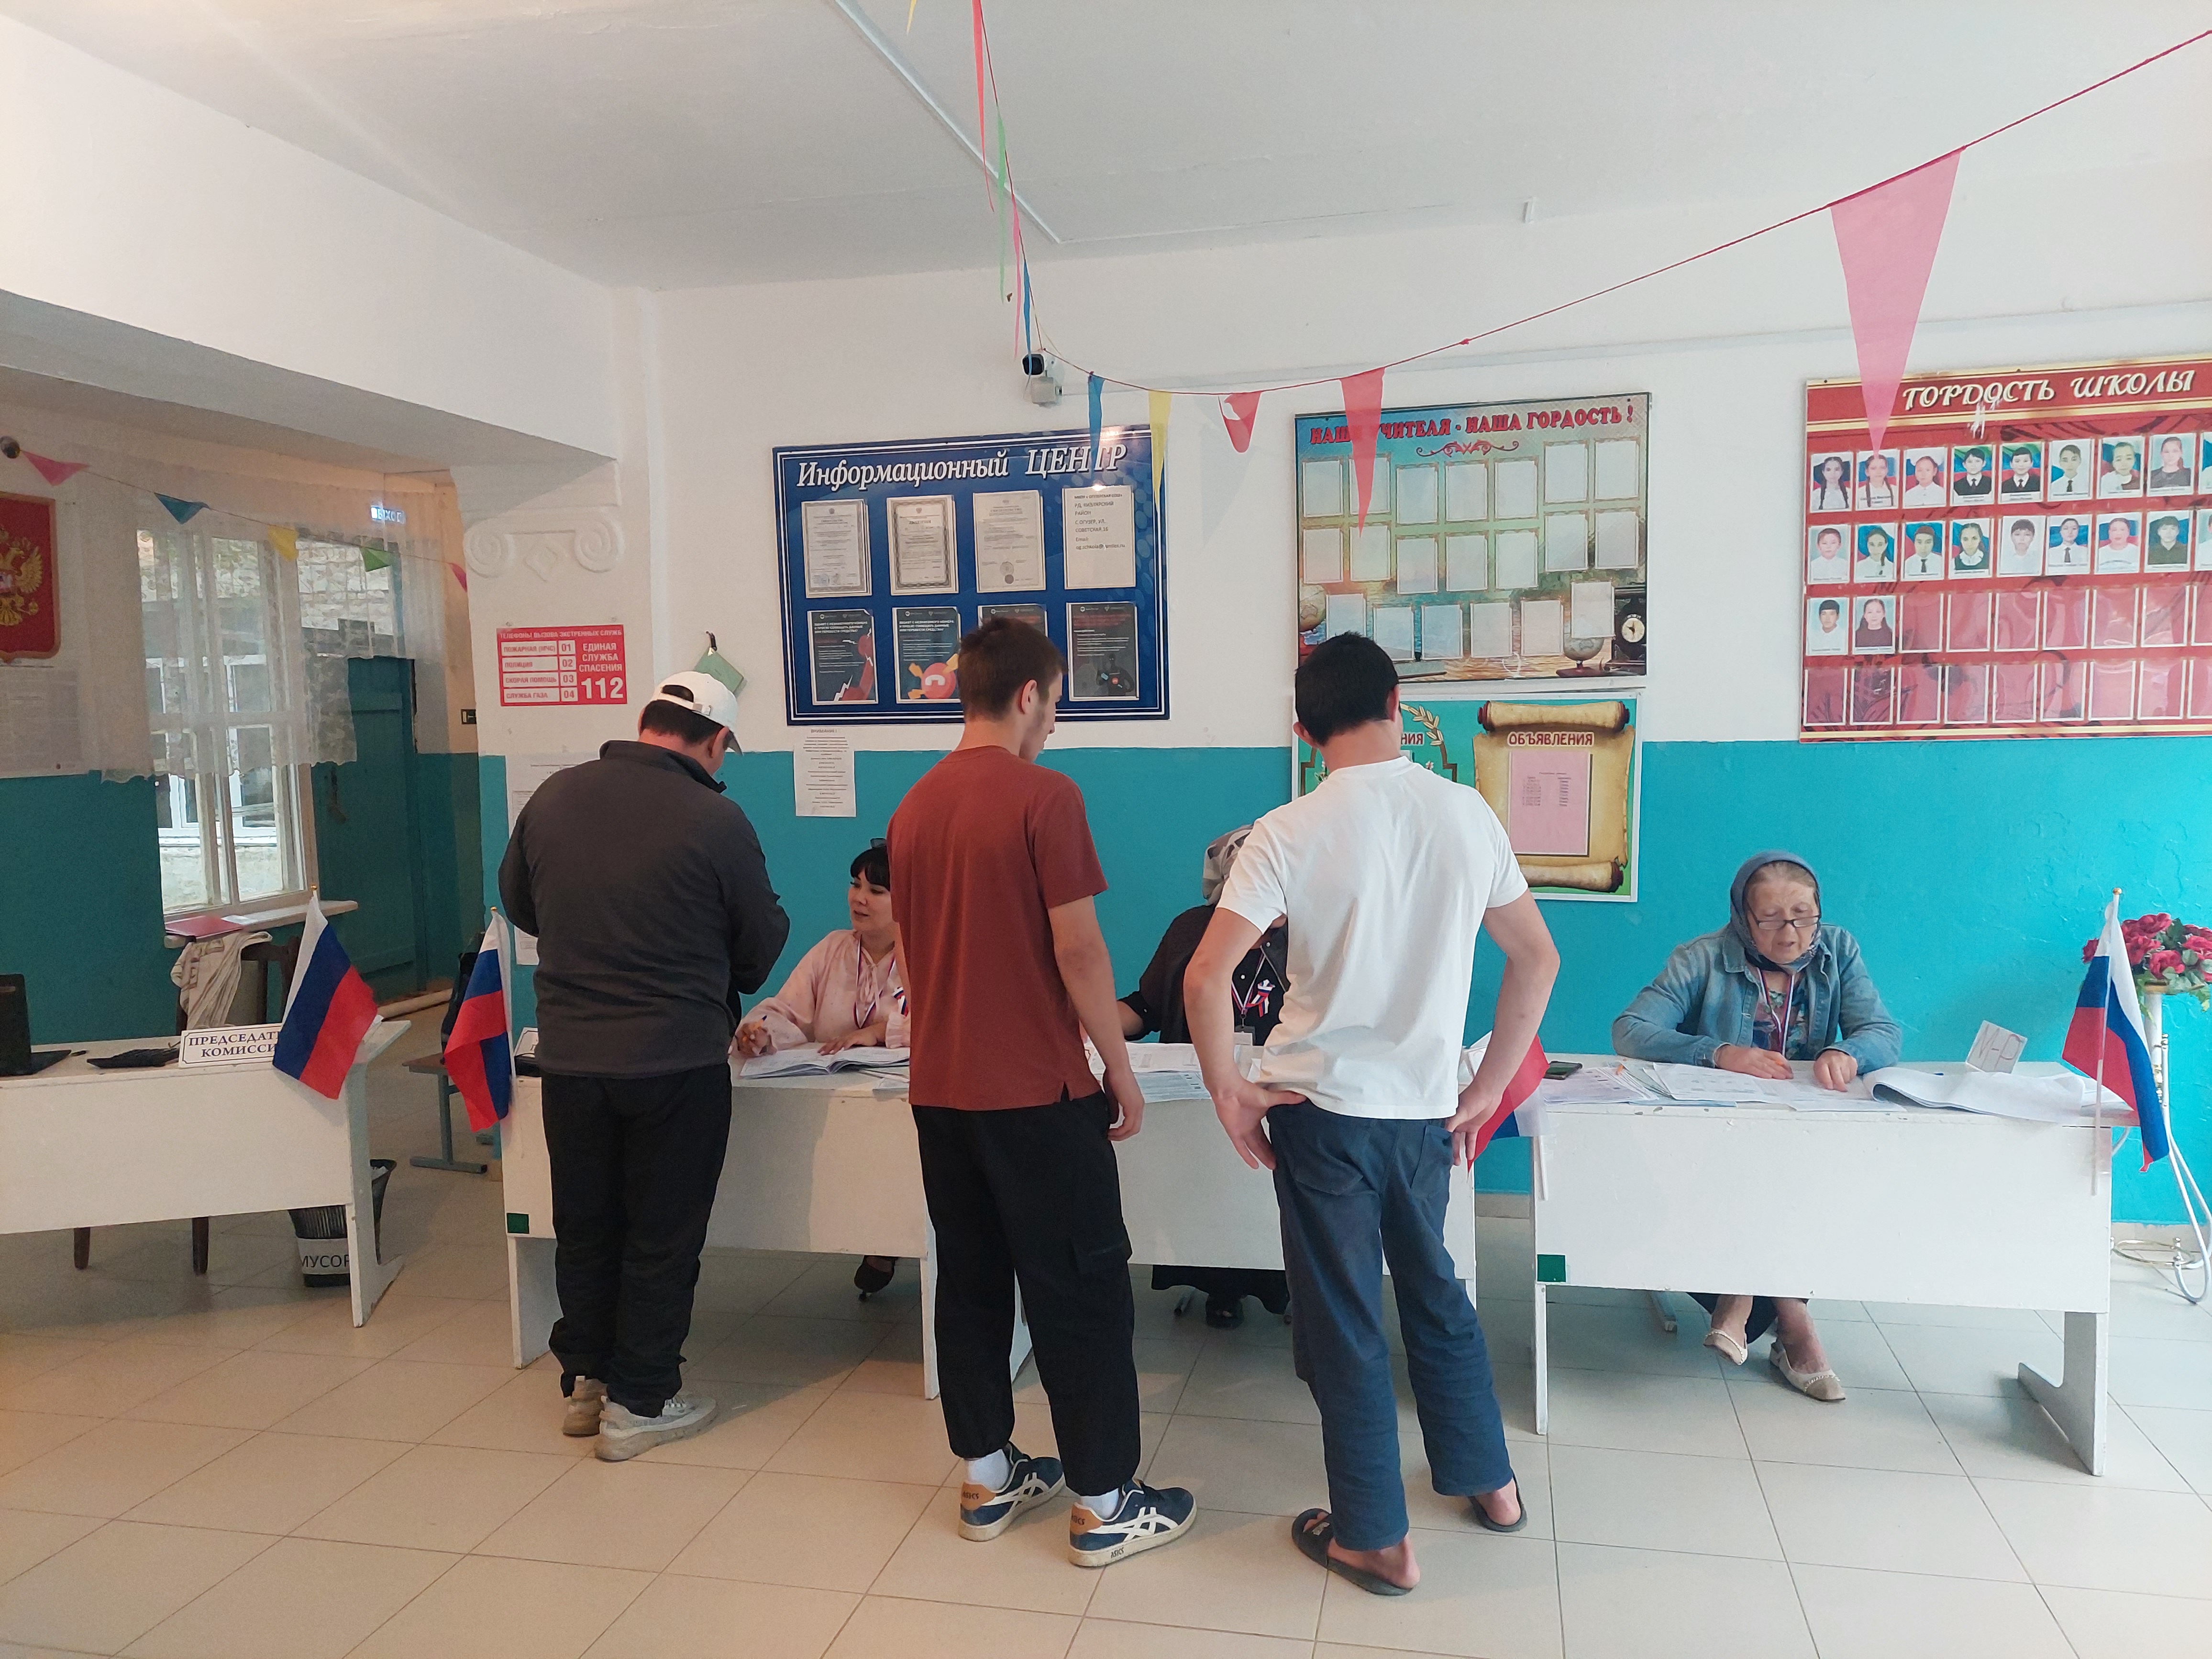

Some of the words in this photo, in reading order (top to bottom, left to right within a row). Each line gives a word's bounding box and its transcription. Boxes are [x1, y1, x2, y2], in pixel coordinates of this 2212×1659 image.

[1902, 380, 2055, 410] ГОРДОСТЬ
[2071, 370, 2195, 399] ШКОЛЫ
[1466, 413, 1522, 433] НАША
[796, 449, 1009, 491] Информационный
[561, 643, 572, 652] 01
[583, 642, 617, 653] ЕДИНАЯ
[562, 659, 573, 667] 02
[582, 653, 619, 662] СЛУЖБА
[579, 664, 623, 673] СПАСЕНИЯ
[563, 675, 574, 683] 03
[581, 677, 624, 699] 112
[564, 690, 575, 698] 04
[1508, 733, 1593, 746] ОБЪЯВЛЕНИЯ
[1110, 1547, 1125, 1559] ASICS
